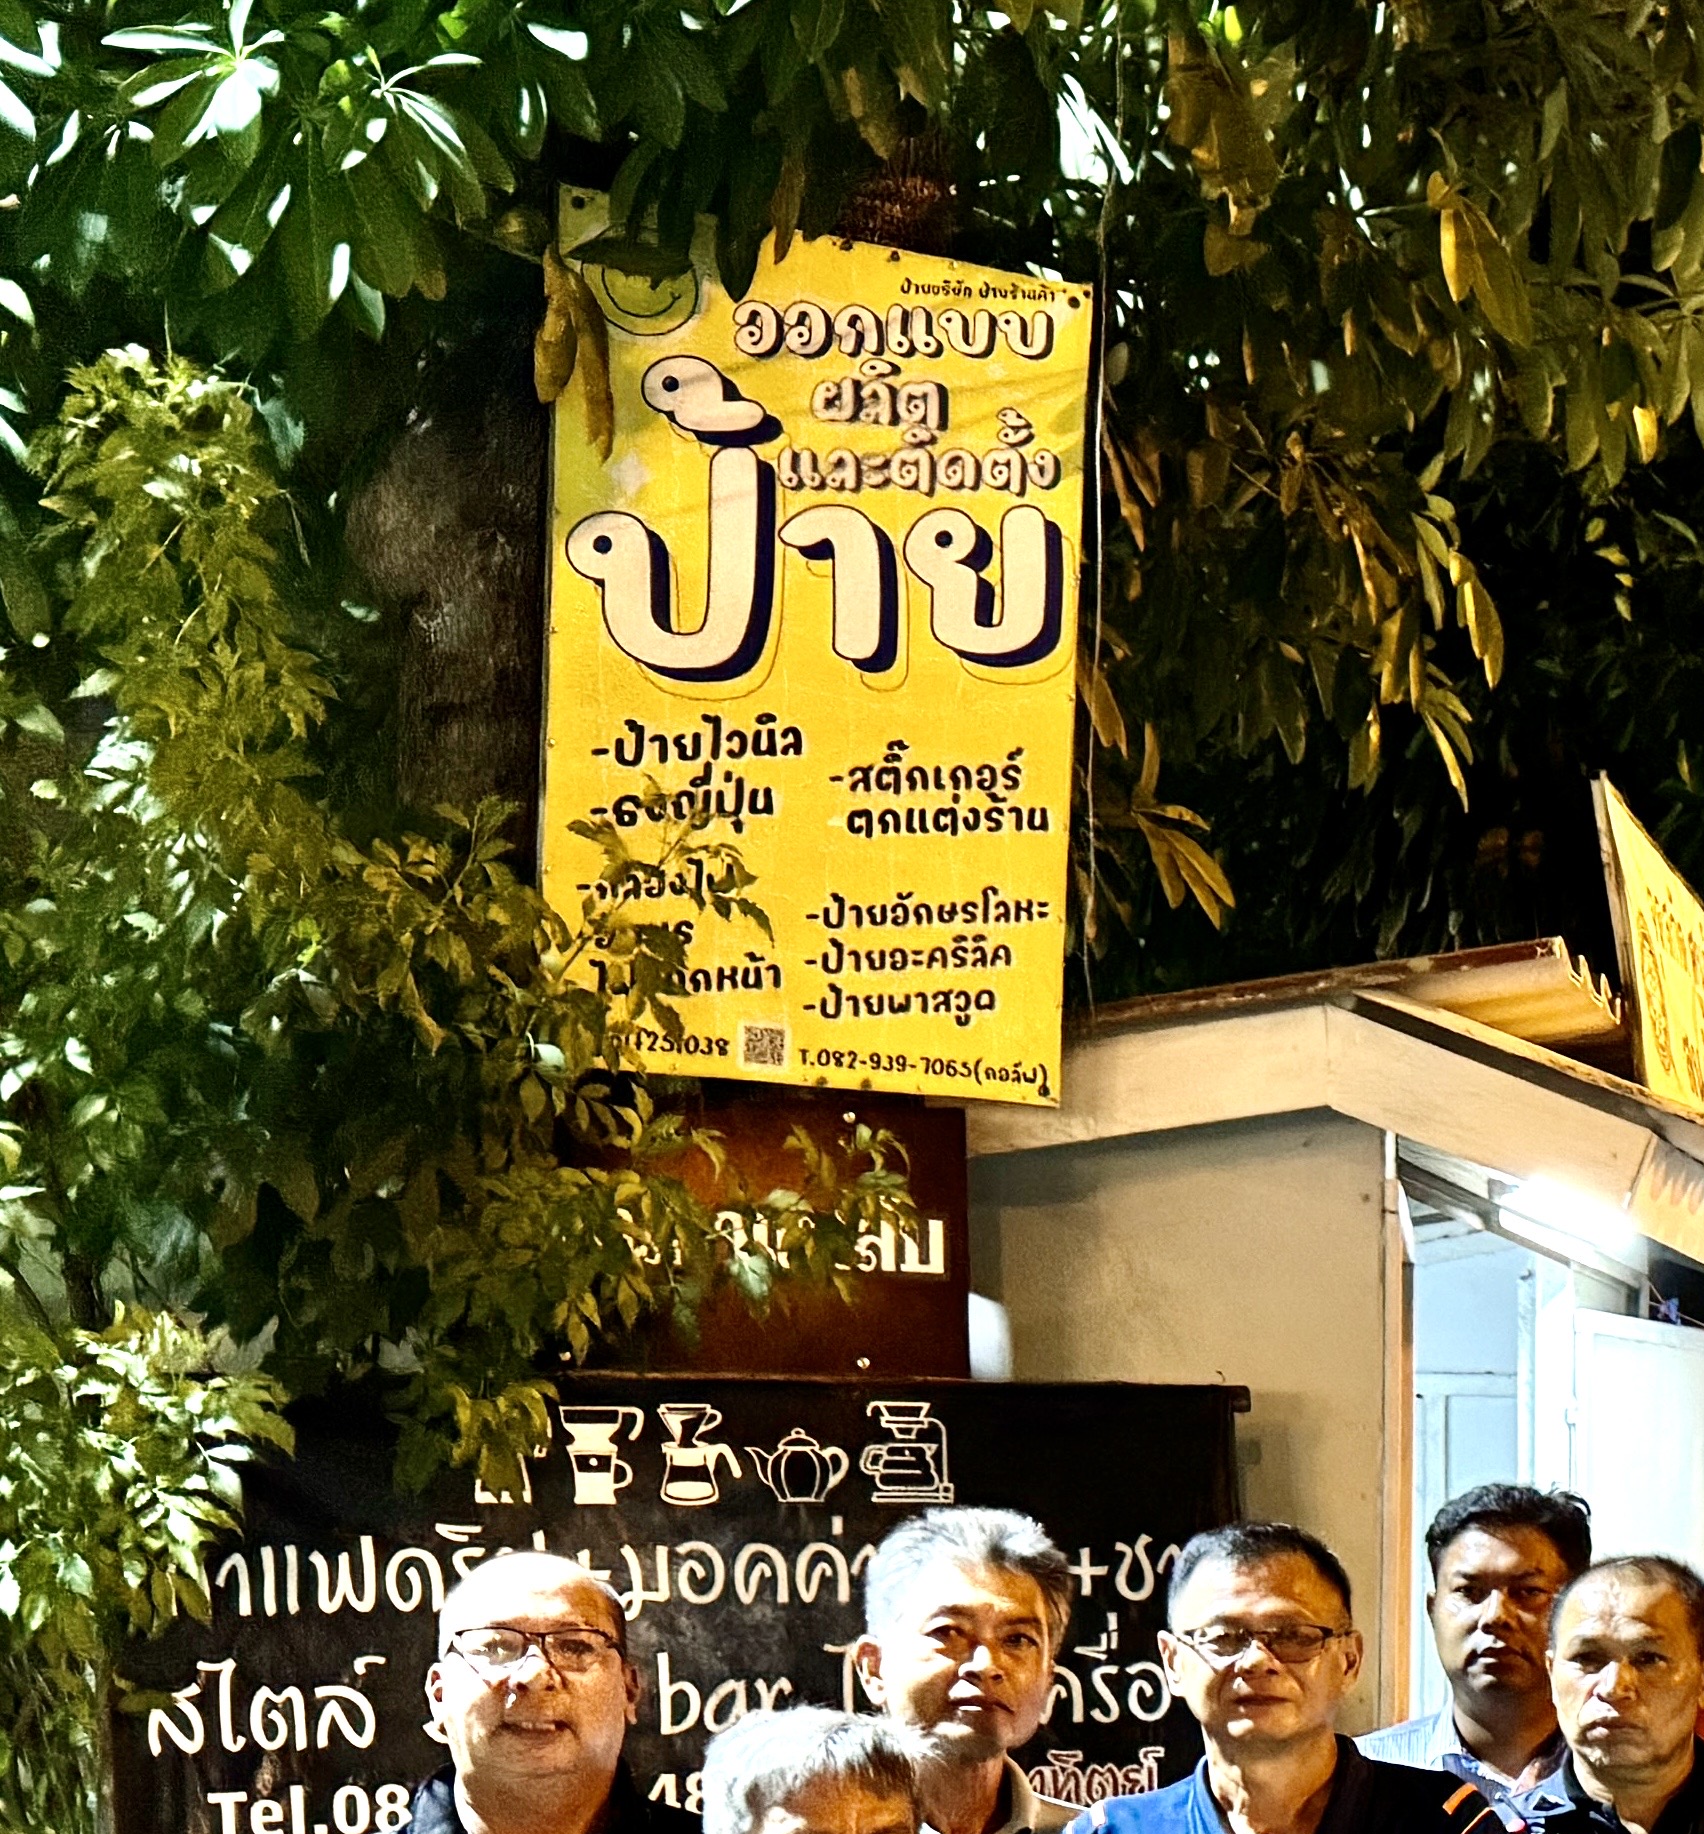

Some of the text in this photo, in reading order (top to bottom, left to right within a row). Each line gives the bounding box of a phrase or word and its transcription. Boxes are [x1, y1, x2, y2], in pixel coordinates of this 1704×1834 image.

[732, 300, 1055, 360] ออกแบบ
[811, 358, 949, 431] ผลิต
[776, 407, 1061, 496] และติดตั้ง
[566, 354, 1065, 684] ป้าย
[147, 1653, 387, 1758] สไตล์
